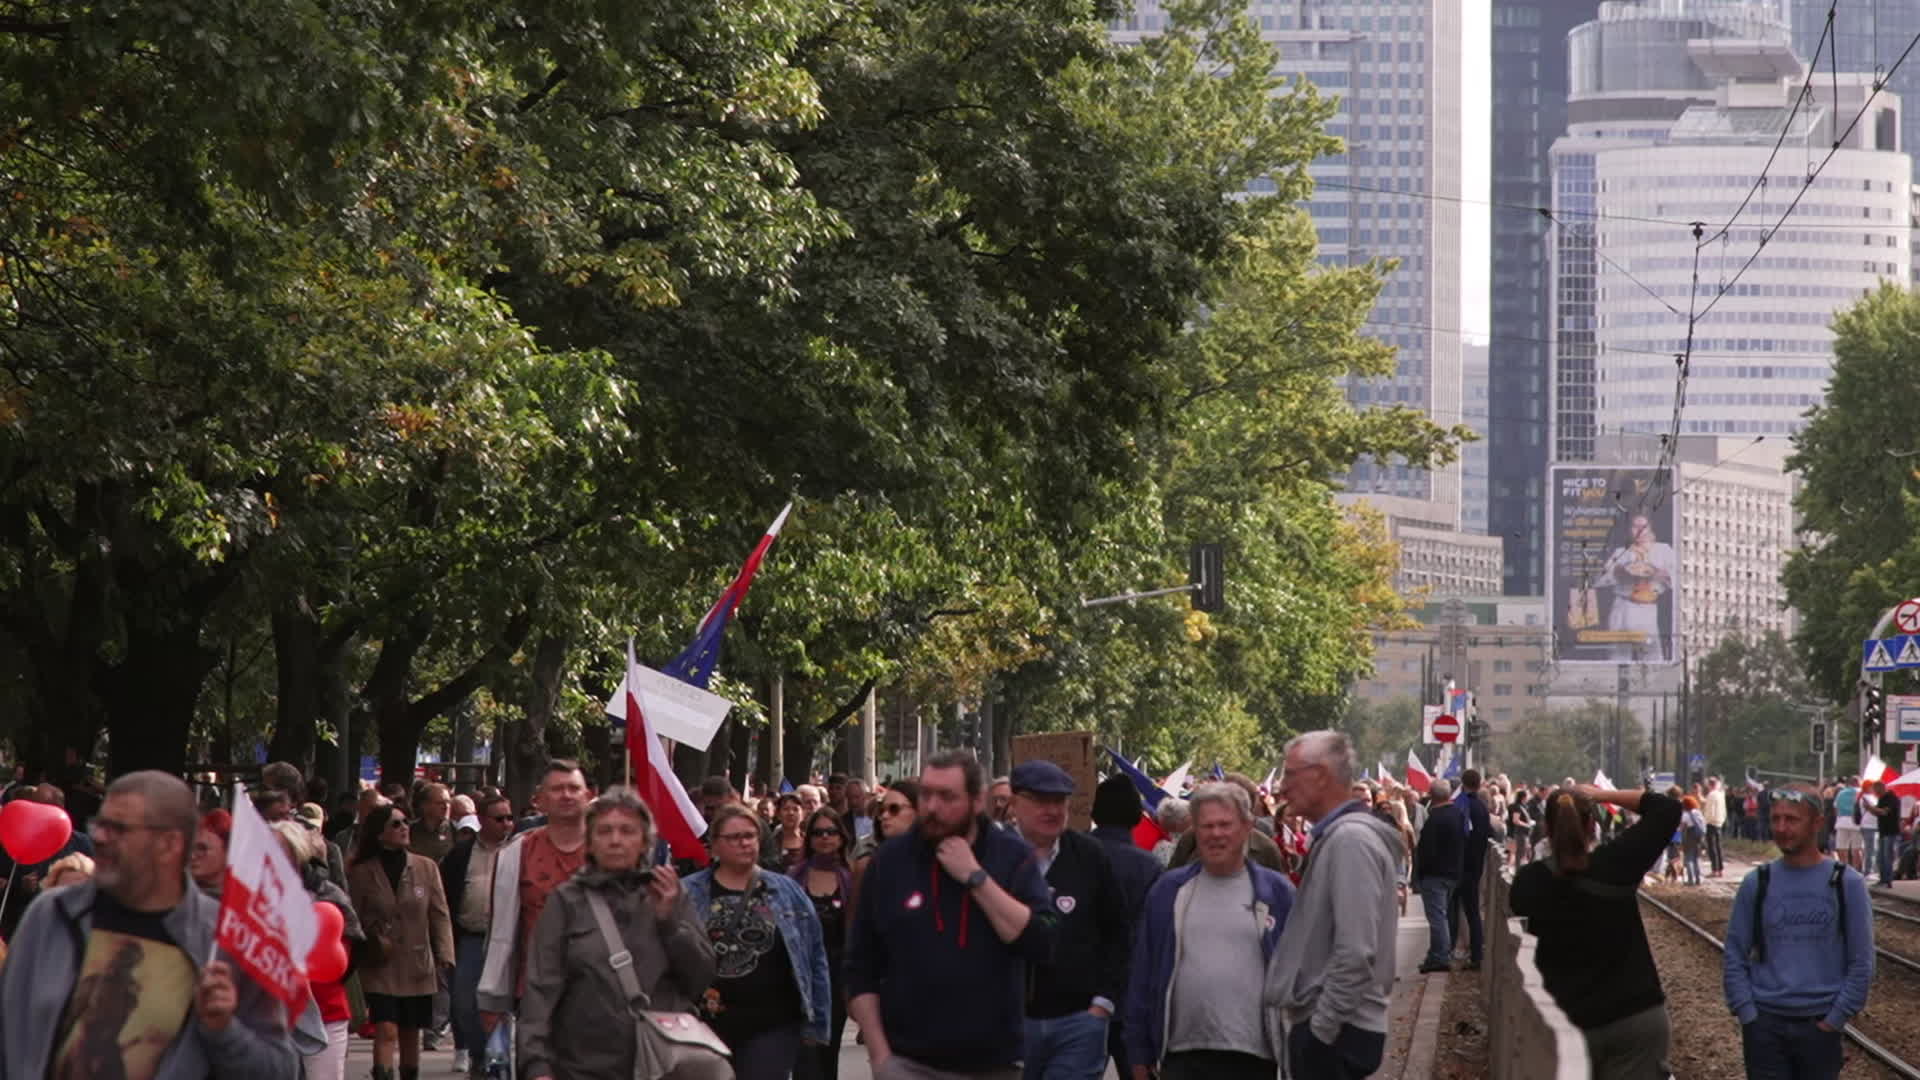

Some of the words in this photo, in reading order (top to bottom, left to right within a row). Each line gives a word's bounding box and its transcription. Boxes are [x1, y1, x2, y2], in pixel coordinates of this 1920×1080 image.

[1562, 479, 1588, 489] NICE
[1592, 479, 1607, 489] TO
[1562, 488, 1582, 497] FIT
